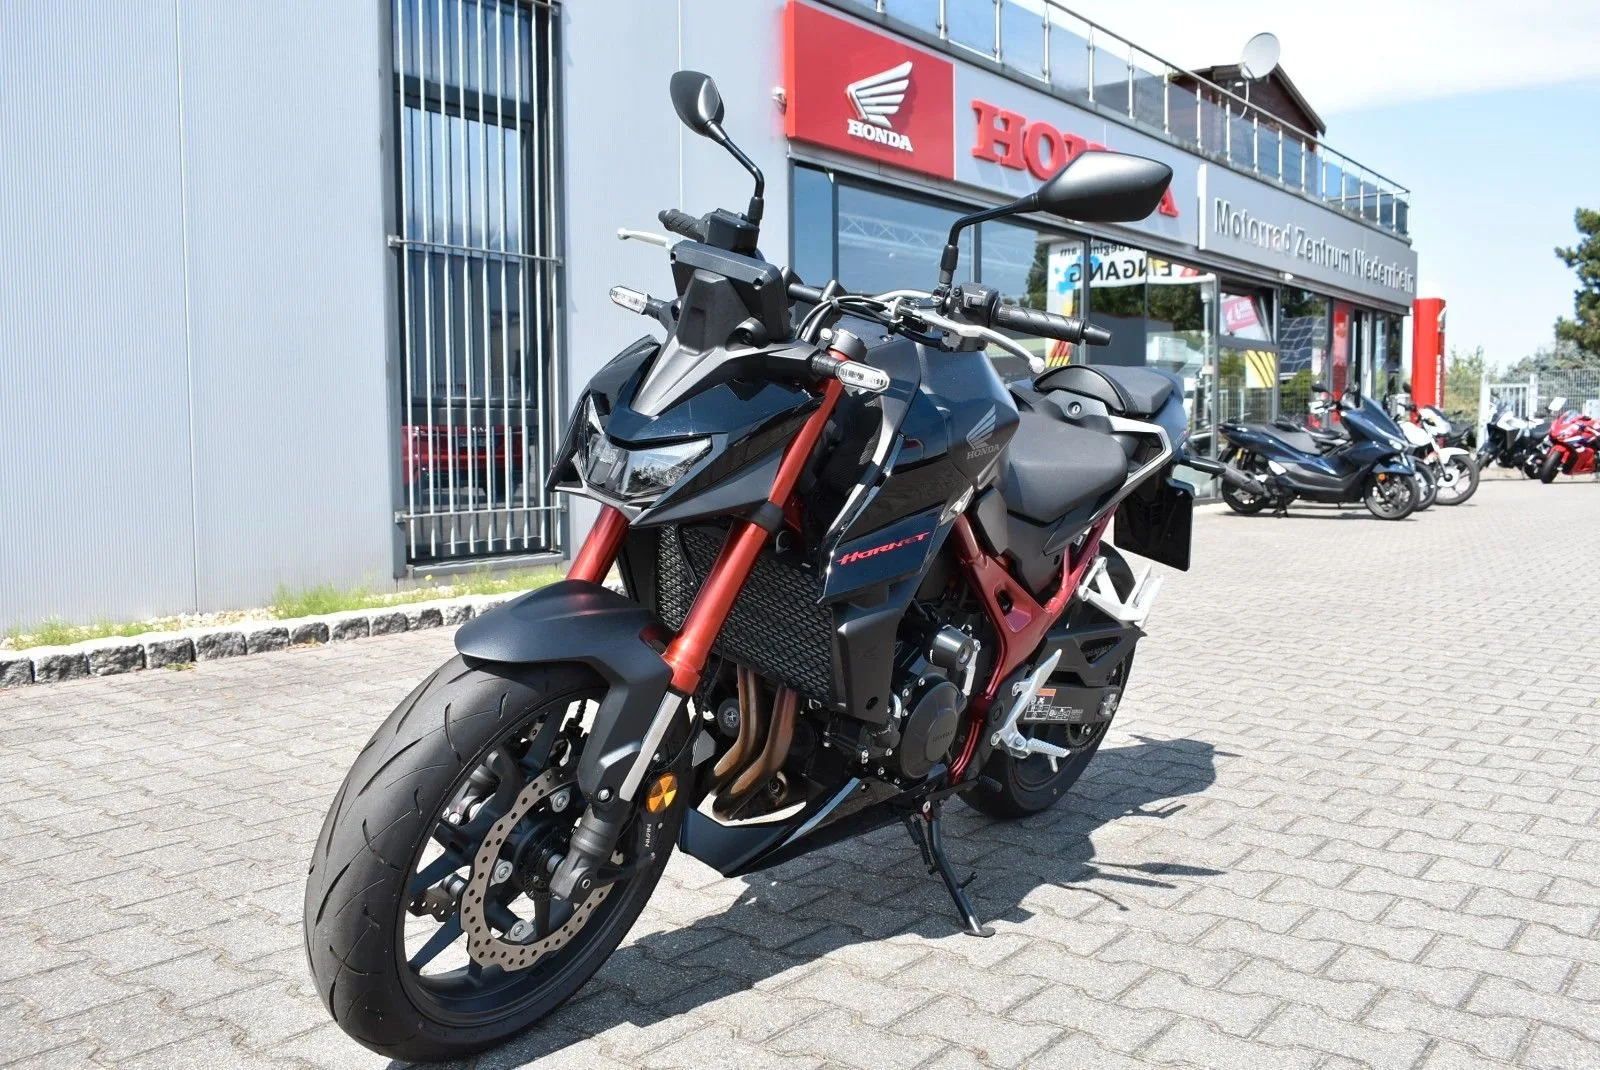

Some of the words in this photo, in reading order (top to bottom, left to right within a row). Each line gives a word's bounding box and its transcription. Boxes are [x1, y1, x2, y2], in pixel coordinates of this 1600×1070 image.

[847, 118, 913, 152] HONDA
[1214, 197, 1291, 250] Motorrad
[1294, 226, 1350, 273] Zentrum
[966, 443, 1000, 460] HONDA
